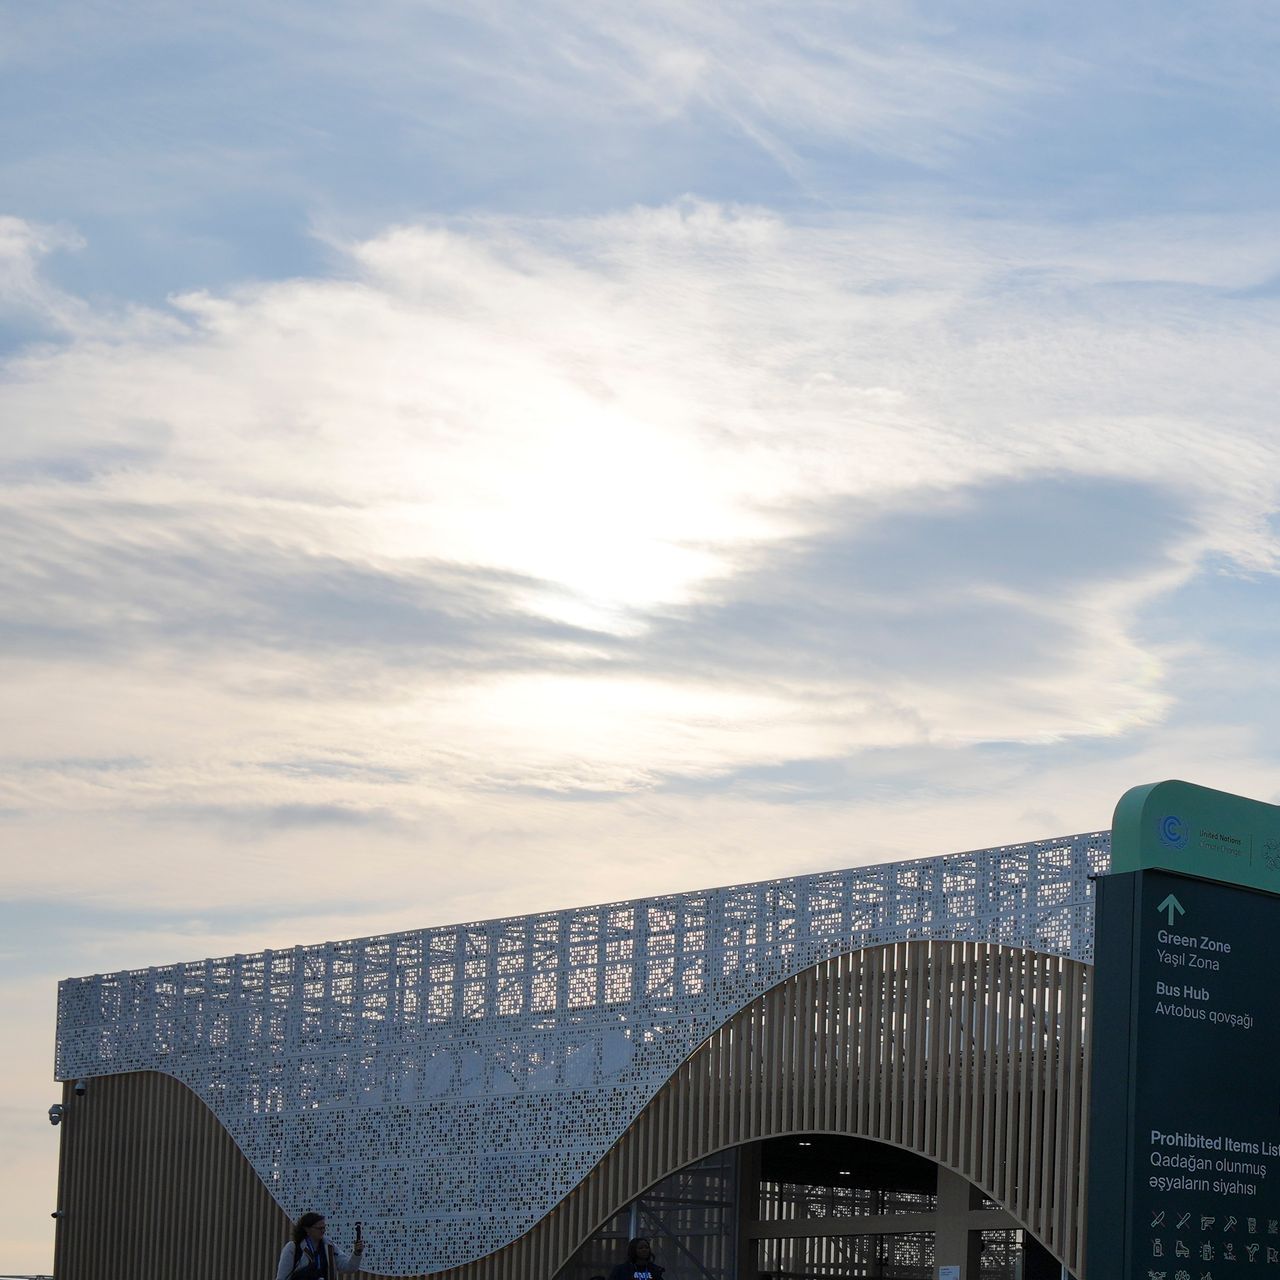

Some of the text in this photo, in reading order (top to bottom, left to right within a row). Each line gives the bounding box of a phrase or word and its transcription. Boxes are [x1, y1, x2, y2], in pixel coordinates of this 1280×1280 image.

[1220, 834, 1241, 846] Nations
[1157, 929, 1231, 953] Green Zone
[1157, 949, 1219, 971] Yaşıl Zona
[1156, 981, 1210, 1001] Bus Hub
[1155, 1001, 1253, 1029] Avtobus qovşağı
[1151, 1130, 1222, 1151] Prohibited
[1225, 1137, 1259, 1154] Items
[1150, 1151, 1267, 1179] Qadağan olunmuş
[1149, 1176, 1257, 1196] əşyaların siyahısı
